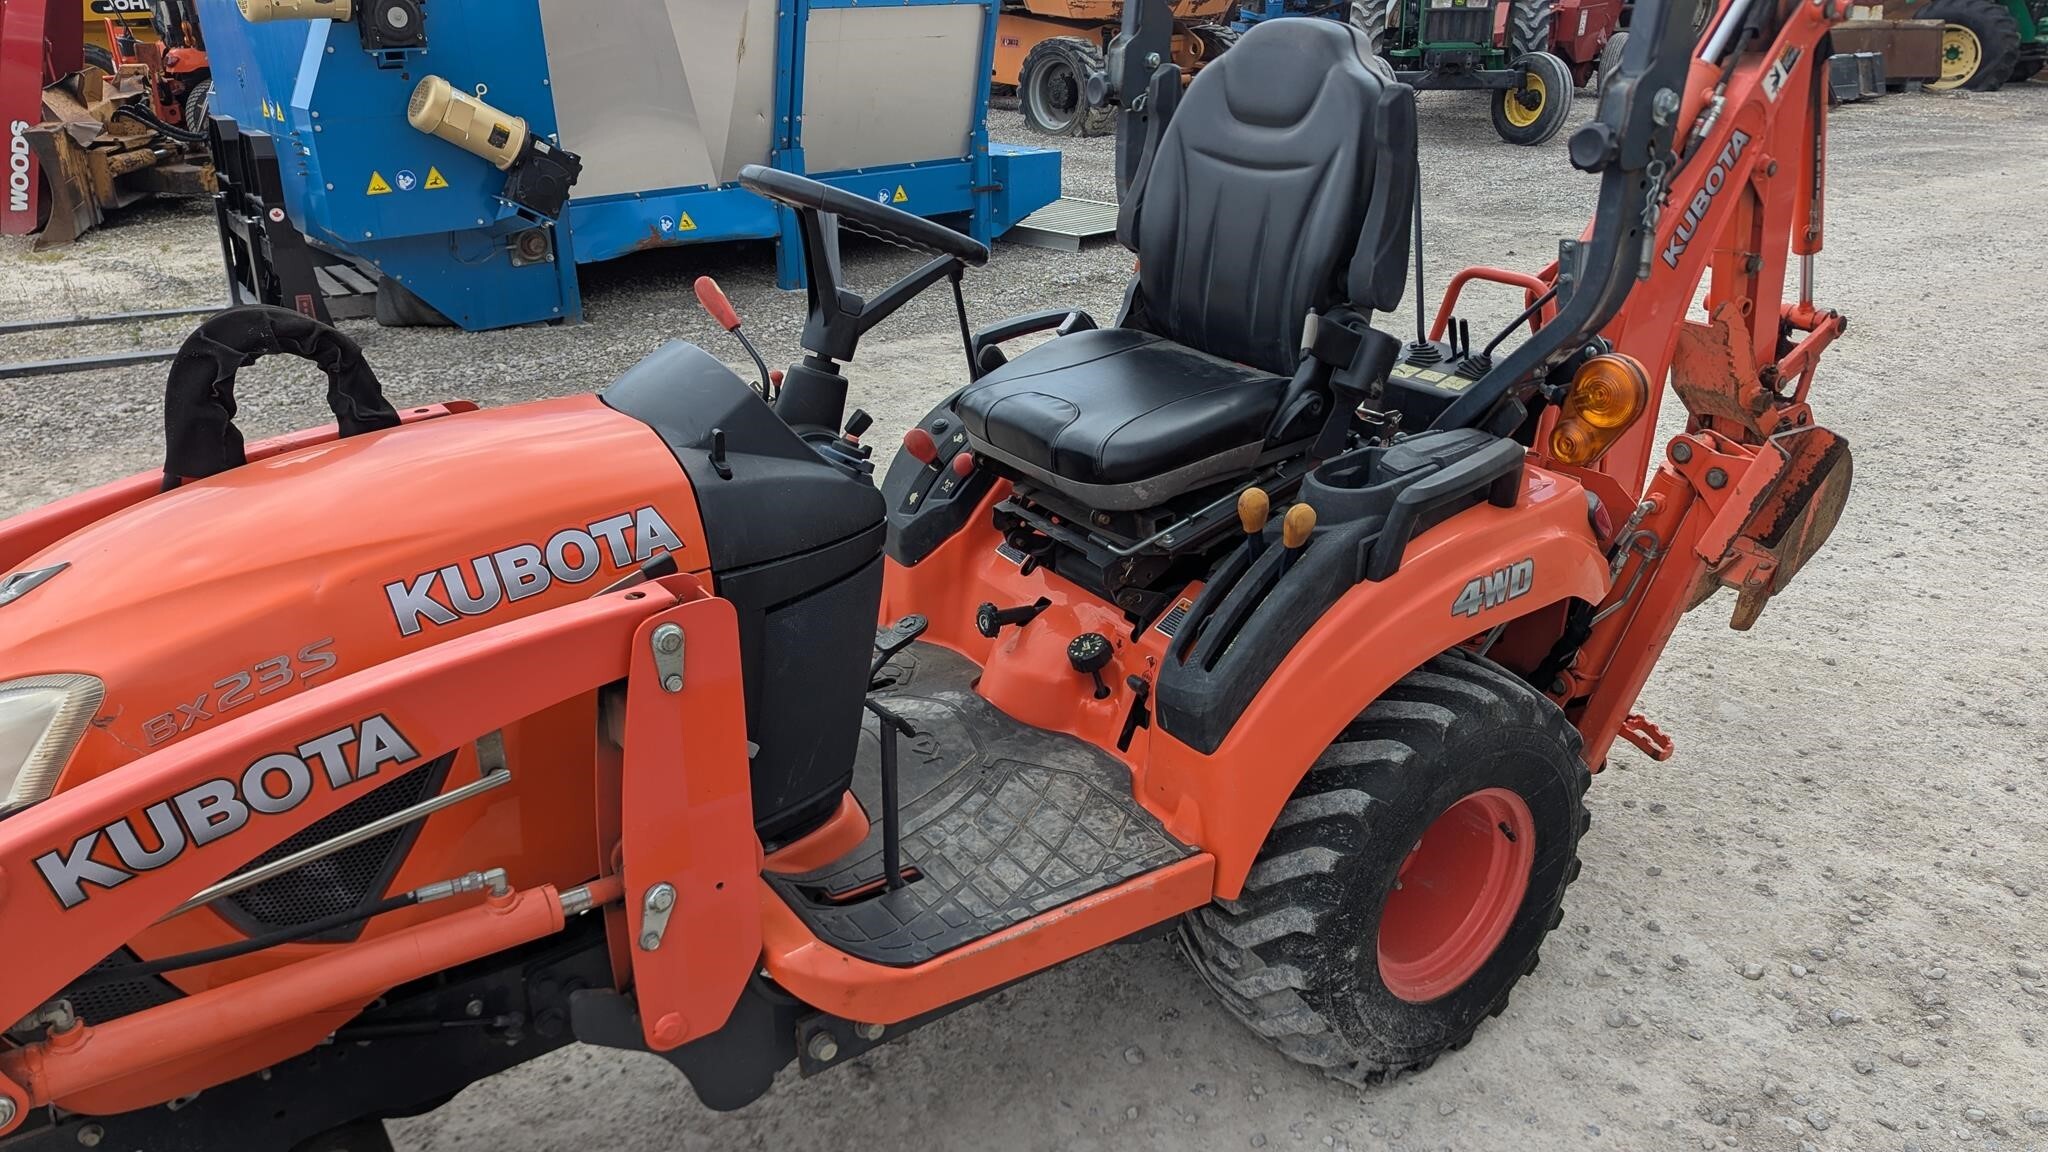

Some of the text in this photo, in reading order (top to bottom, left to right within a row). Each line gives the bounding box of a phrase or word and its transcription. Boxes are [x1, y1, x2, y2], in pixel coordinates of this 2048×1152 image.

[10, 120, 29, 211] WOODS
[1661, 128, 1752, 270] KUBOTA
[384, 505, 686, 637] KUBOTA
[1451, 557, 1534, 618] 4WD
[142, 637, 337, 747] BX23S
[33, 713, 421, 911] KUBOTA
